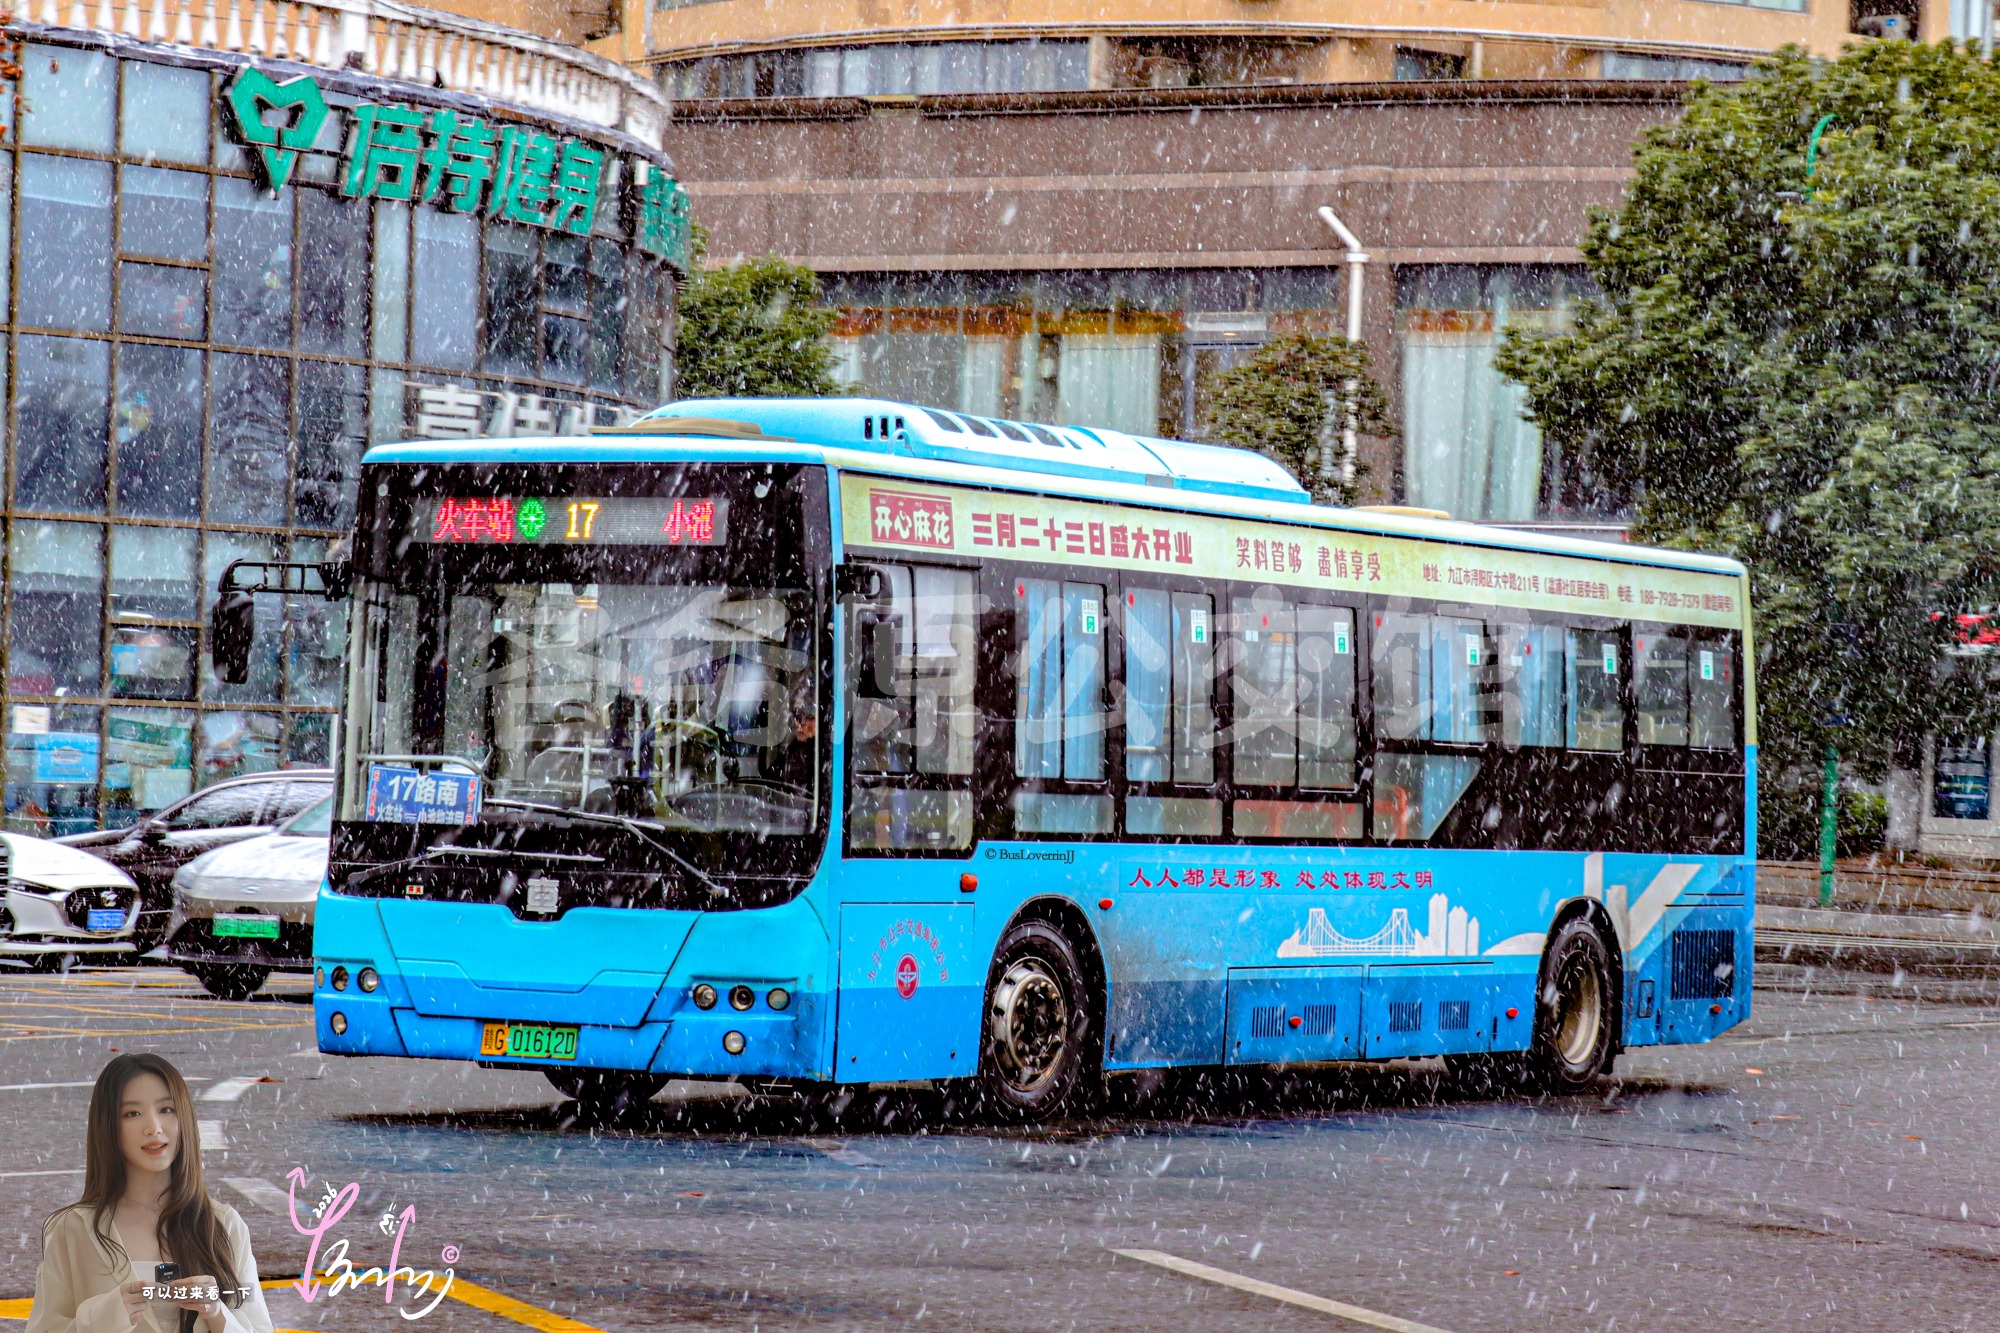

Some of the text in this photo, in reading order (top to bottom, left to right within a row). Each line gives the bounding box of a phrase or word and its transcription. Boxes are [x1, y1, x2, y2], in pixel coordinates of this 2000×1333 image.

[433, 499, 513, 542] 火车站
[566, 503, 599, 539] 17
[874, 505, 951, 545] 开心麻花
[971, 511, 1194, 566] 三月二十三日盛大开业
[1235, 536, 1303, 574] 笑料管够
[388, 774, 460, 807] 17路南
[375, 802, 403, 823] 火车站
[1128, 866, 1434, 890] 人人都是形象 处处体现文明
